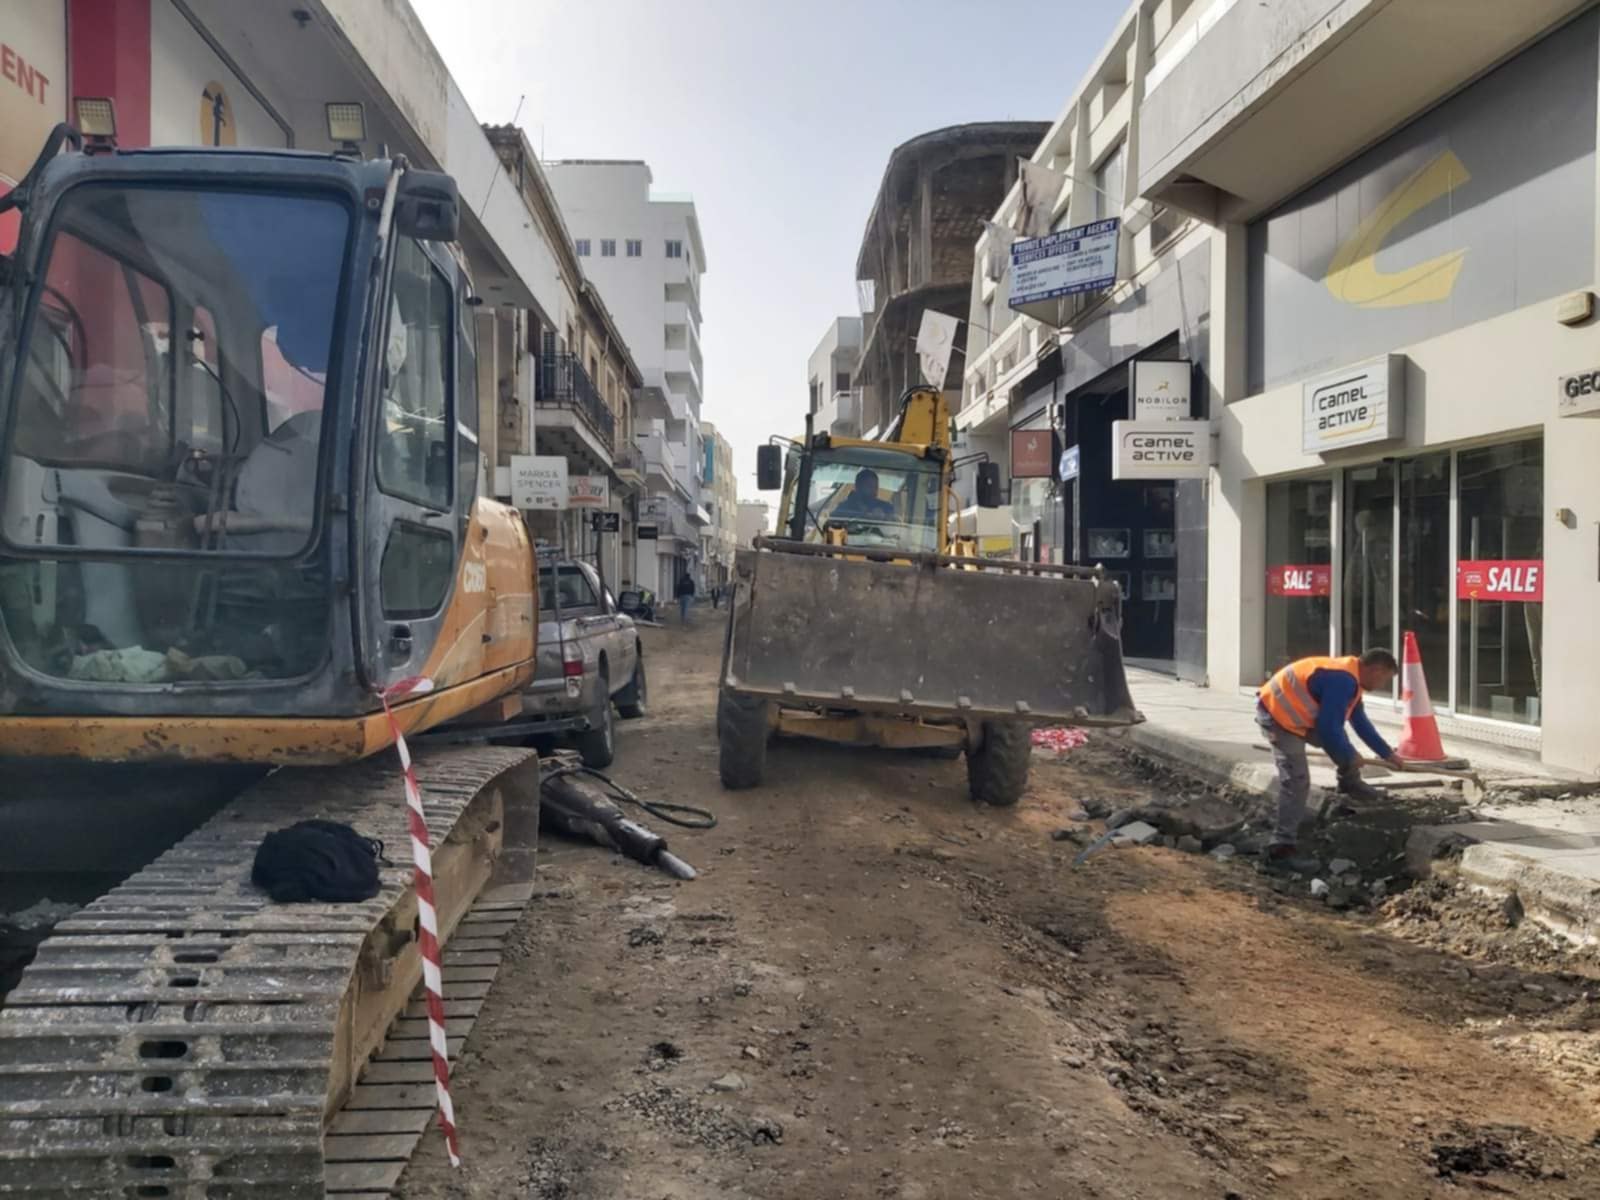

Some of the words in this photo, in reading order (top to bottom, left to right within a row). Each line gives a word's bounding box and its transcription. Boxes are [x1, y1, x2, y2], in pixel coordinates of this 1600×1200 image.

[1, 43, 50, 105] ENT
[1014, 240, 1039, 254] PRIVATE
[1041, 230, 1085, 249] EMPLOYMENT
[1086, 221, 1114, 237] AGENCY
[516, 480, 561, 489] SPENCER
[519, 470, 551, 478] MARKS
[552, 470, 559, 478] &
[1282, 570, 1313, 590] SALE
[1486, 567, 1538, 592] SALE
